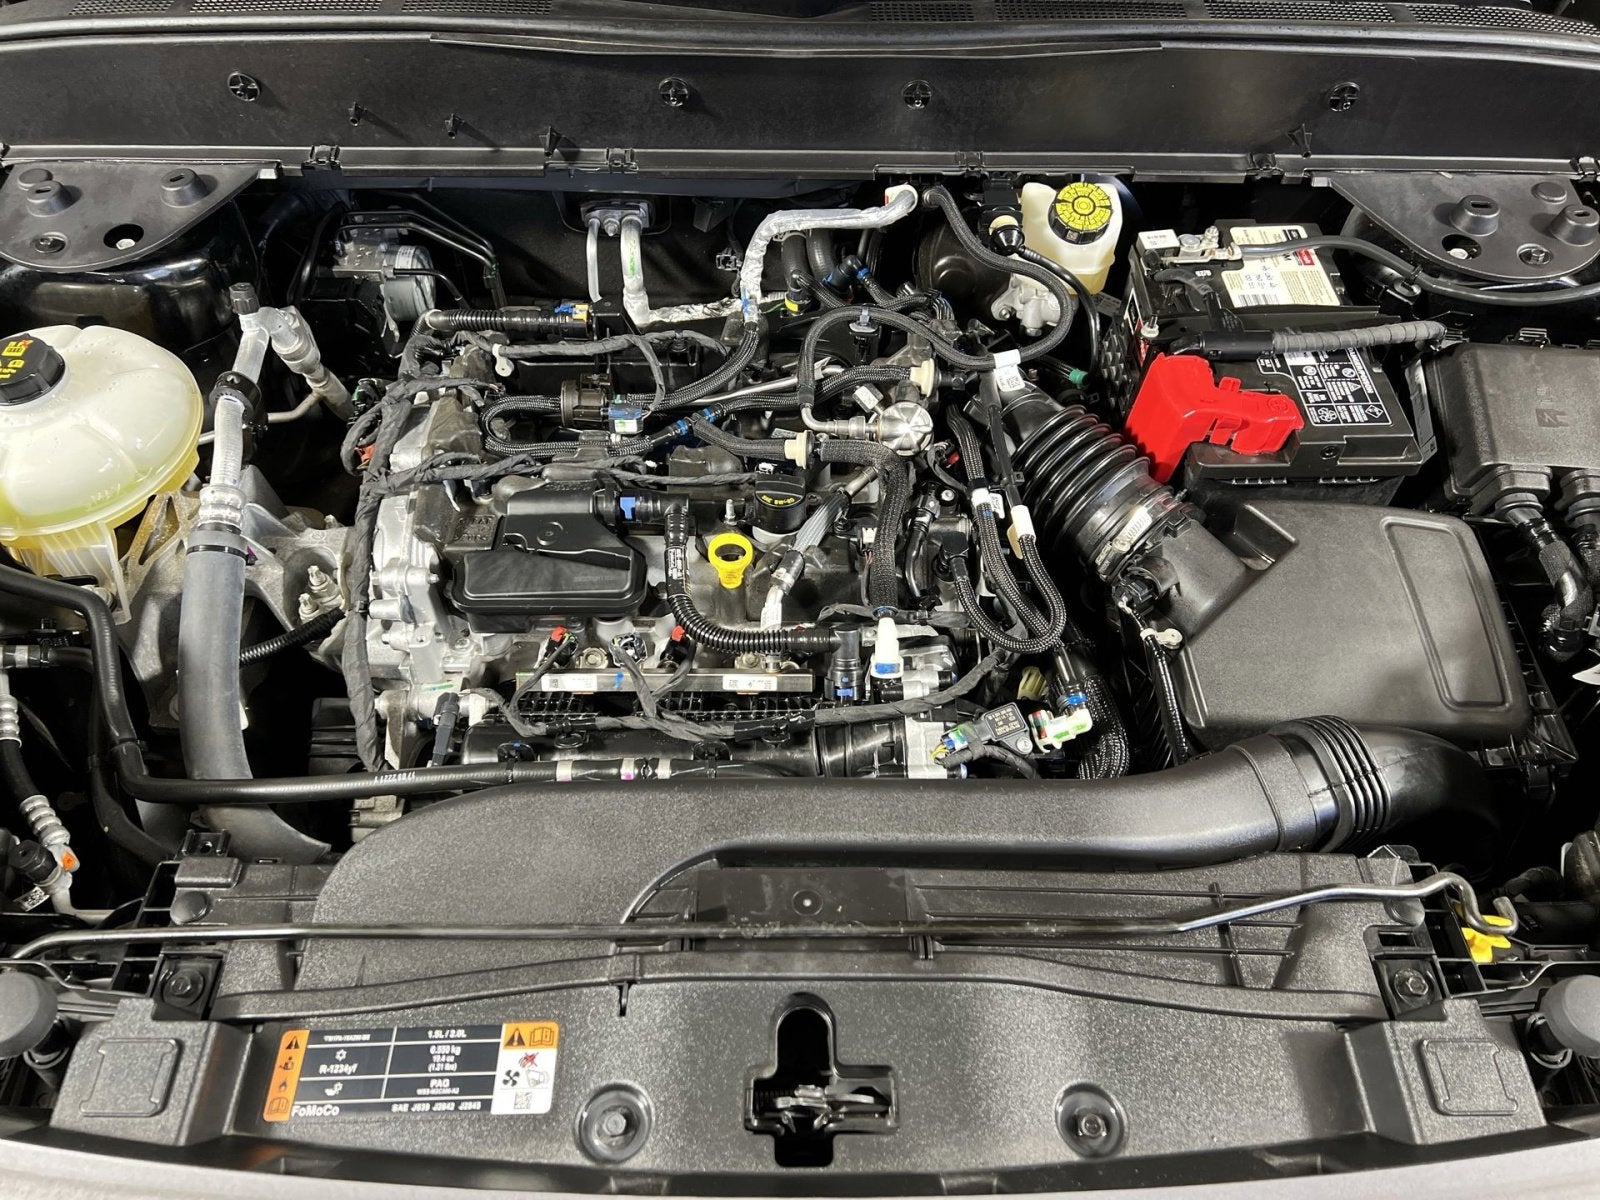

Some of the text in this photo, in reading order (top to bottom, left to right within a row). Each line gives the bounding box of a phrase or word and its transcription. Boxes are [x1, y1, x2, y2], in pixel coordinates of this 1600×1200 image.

[450, 1045, 461, 1056] kg
[291, 1104, 340, 1117] FoMoCo
[391, 1103, 409, 1113] SAE
